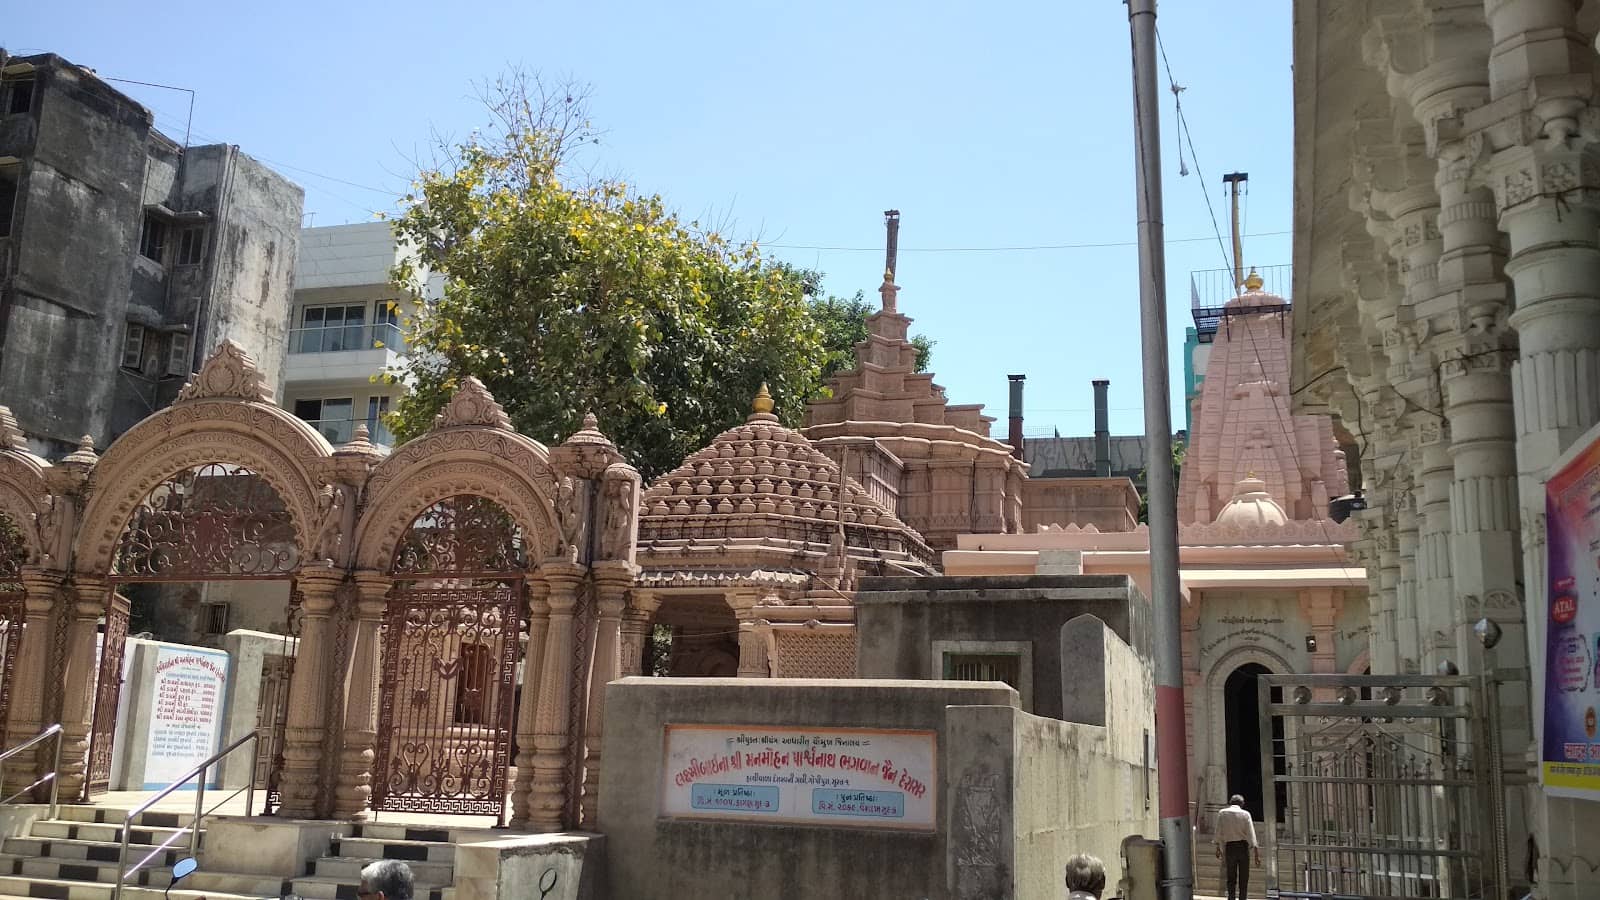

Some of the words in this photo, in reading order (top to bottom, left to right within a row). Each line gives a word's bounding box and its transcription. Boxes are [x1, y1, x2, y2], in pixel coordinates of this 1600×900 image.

[731, 750, 742, 770] શ્રી
[746, 747, 789, 769] મનમોહન
[840, 755, 880, 776] ભગવાન
[882, 760, 898, 784] જૈન
